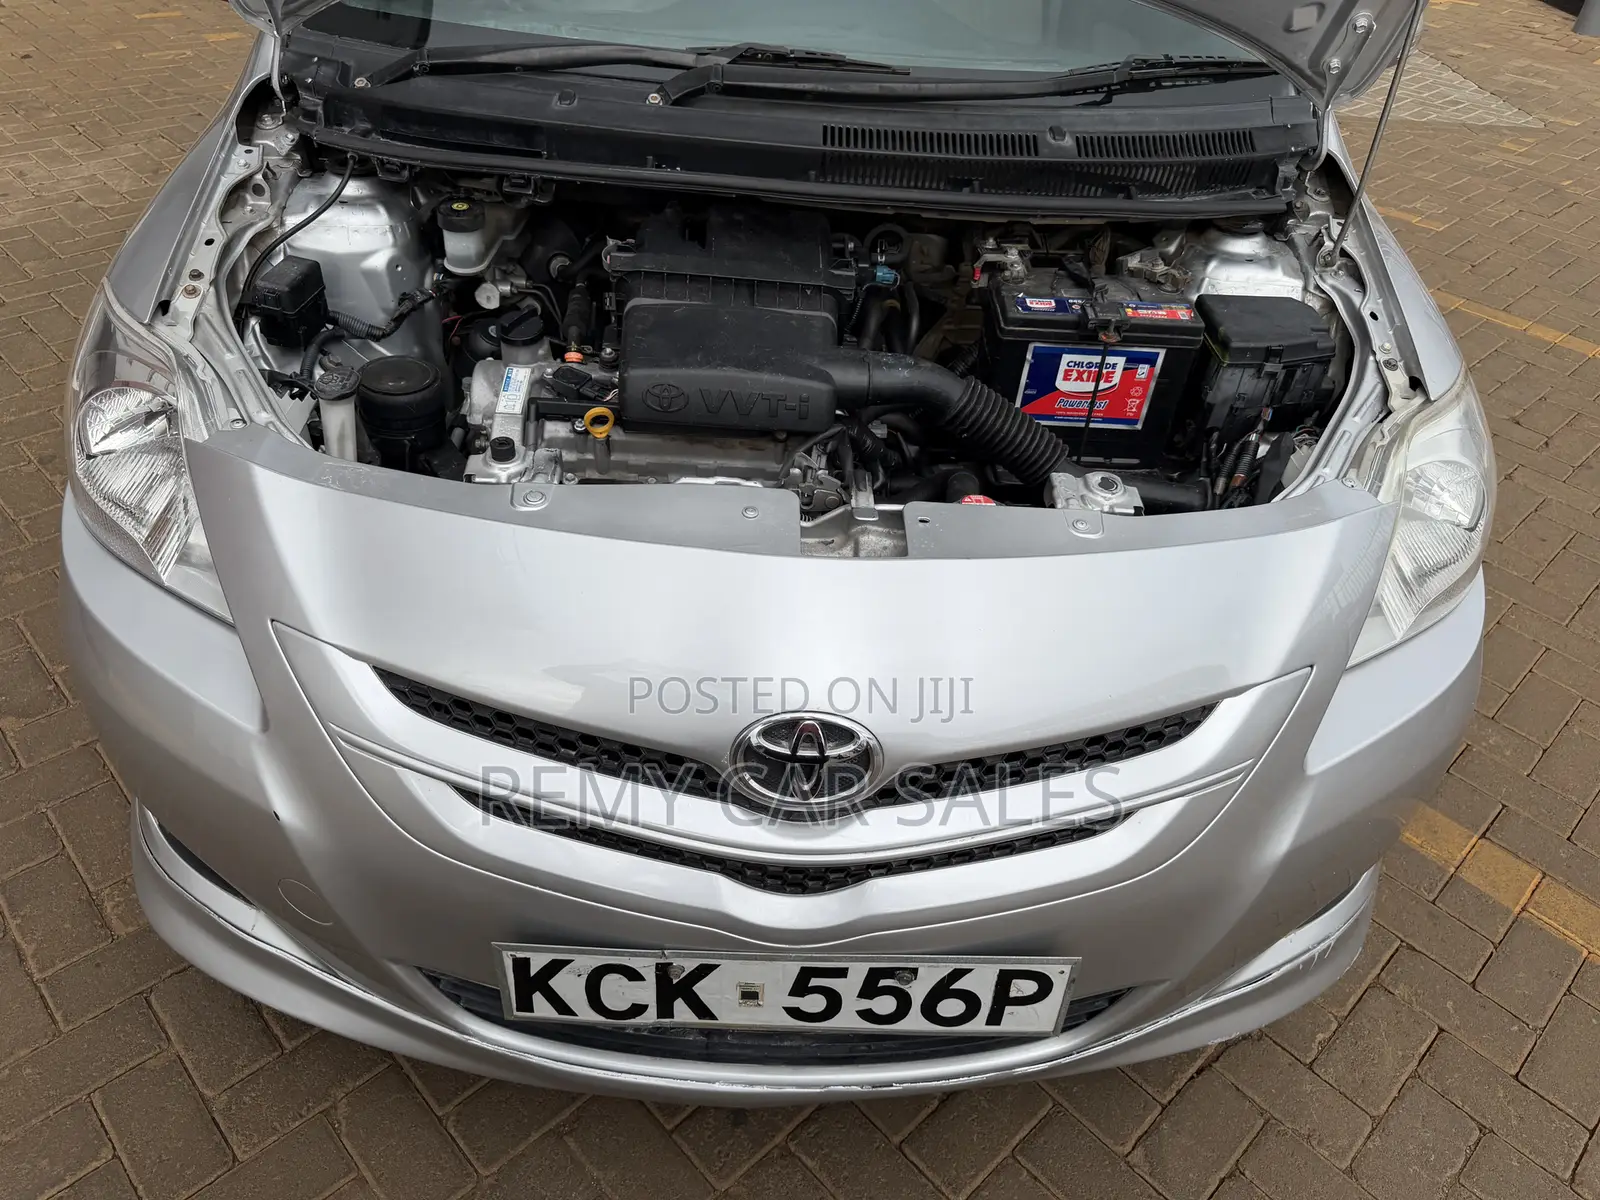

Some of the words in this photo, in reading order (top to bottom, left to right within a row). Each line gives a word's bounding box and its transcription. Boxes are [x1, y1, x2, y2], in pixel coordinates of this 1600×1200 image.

[1066, 360, 1118, 370] CHLORDE
[1062, 368, 1116, 383] EXIDE
[699, 388, 810, 419] VVT-i
[1055, 397, 1109, 410] Powerast
[511, 956, 722, 1021] KCK
[782, 966, 1054, 1027] 556P
